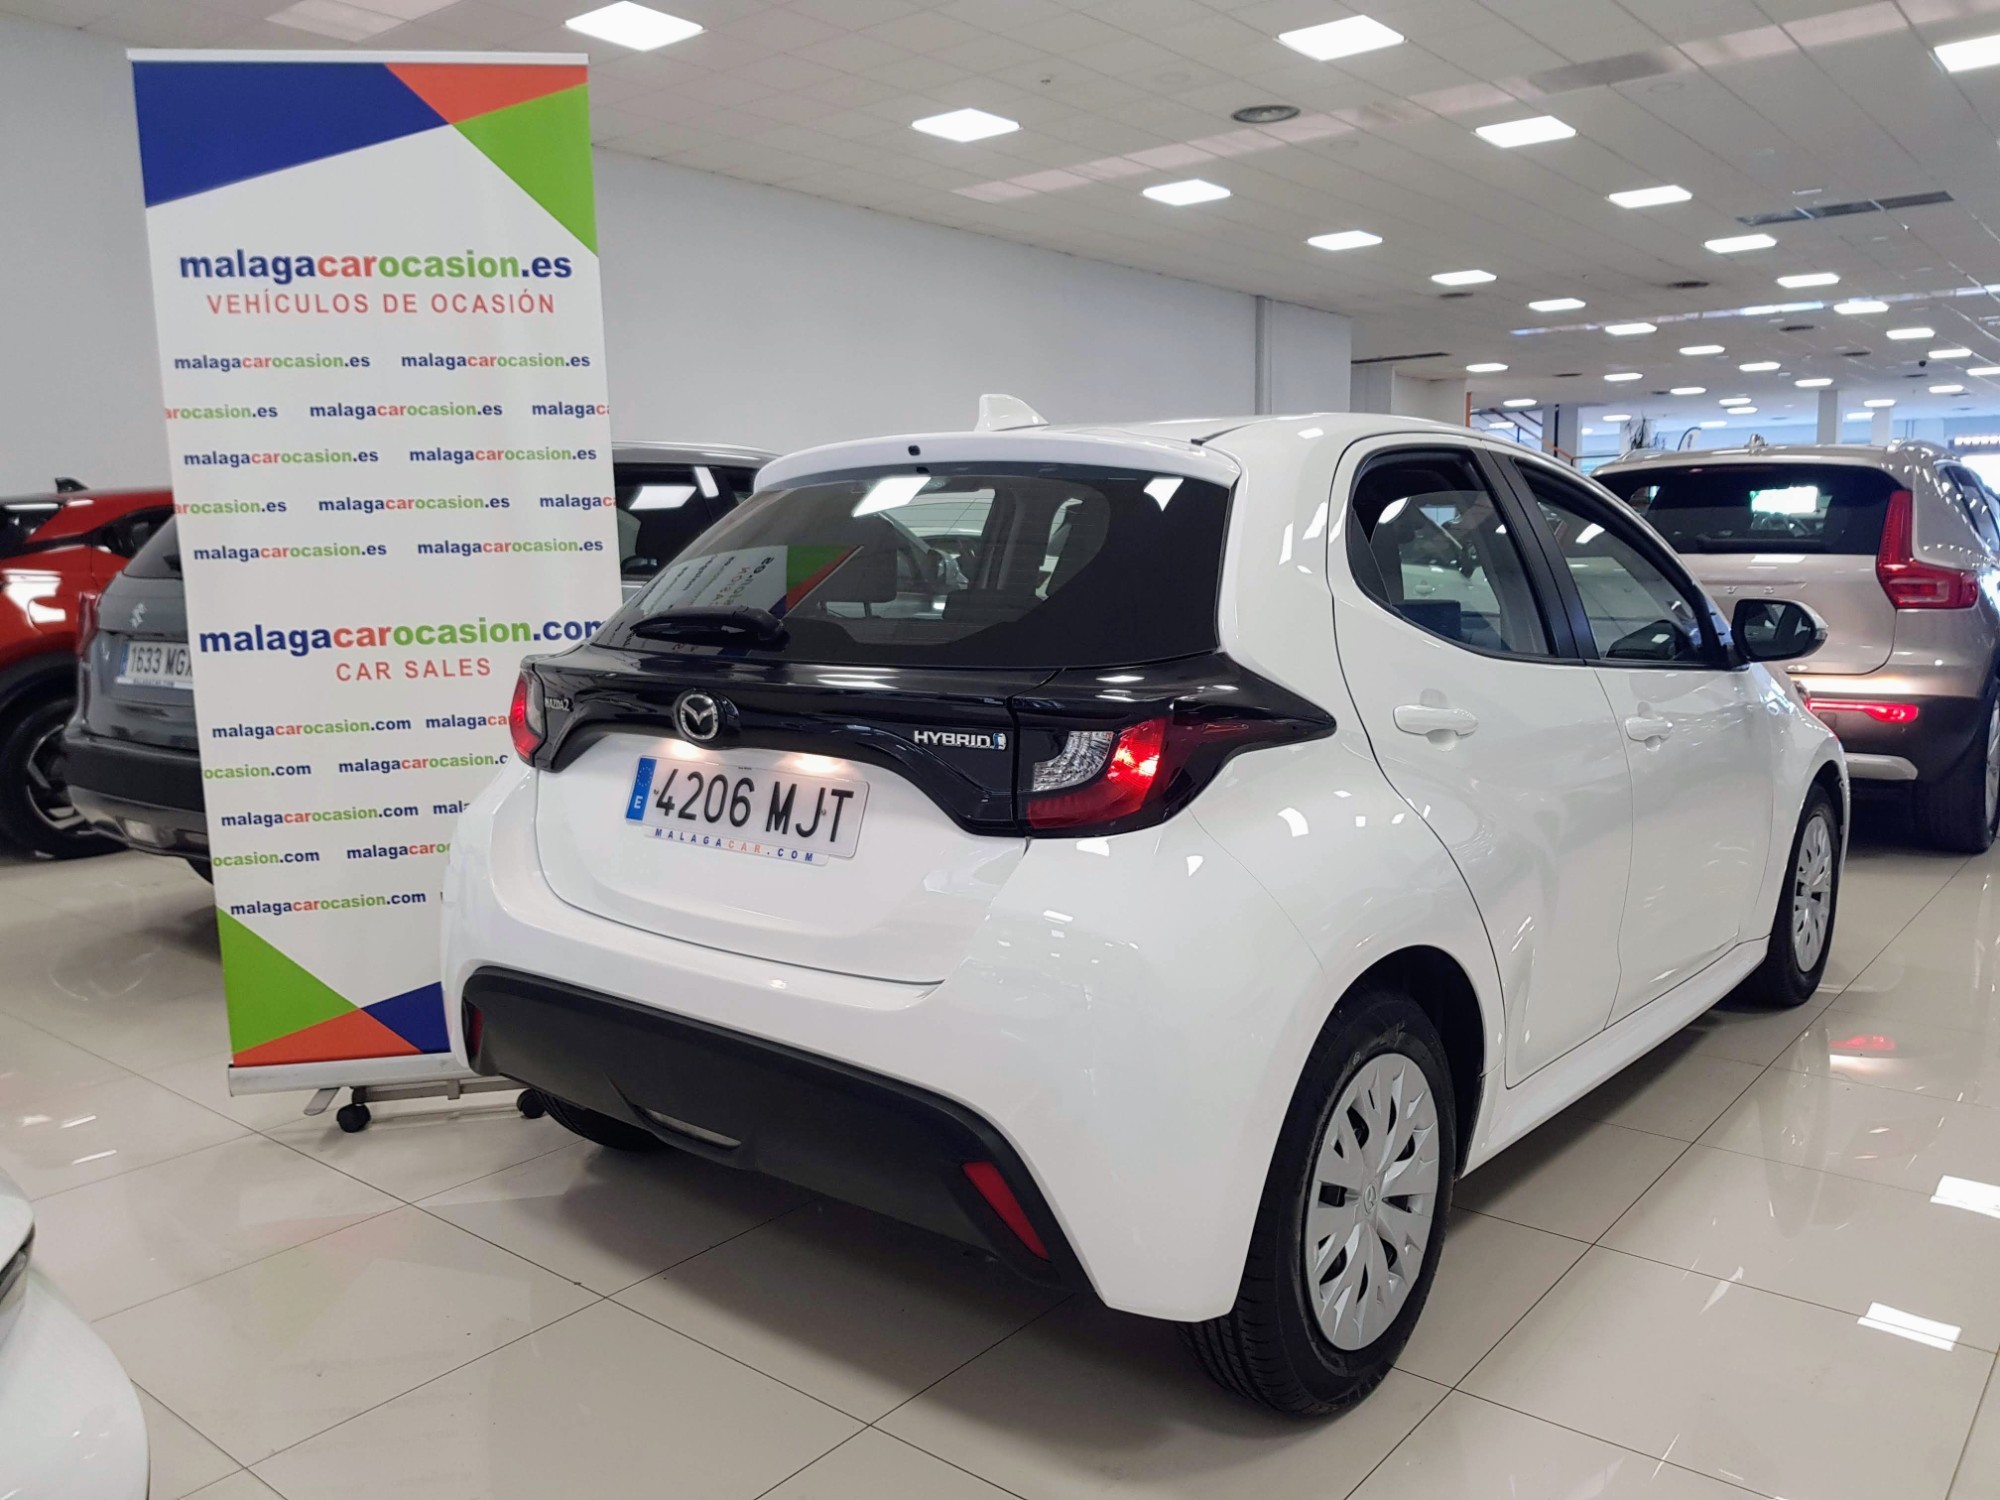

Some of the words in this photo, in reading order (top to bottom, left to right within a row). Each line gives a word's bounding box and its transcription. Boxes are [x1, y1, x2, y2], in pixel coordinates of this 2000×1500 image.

[180, 249, 572, 285] malagacarocasion.es
[207, 290, 368, 314] VEHÍCULOS
[383, 294, 417, 313] DE
[431, 289, 553, 313] OCASIÓN
[175, 354, 370, 372] malagacarocasion.es
[401, 353, 590, 370] malagacarocasion.es
[310, 402, 503, 420] malagacarocasion.es
[184, 450, 378, 468] malagacarocasion.es
[410, 447, 596, 464] malagacarocasion.es
[319, 496, 510, 514] malagacarocasion.es
[194, 543, 387, 562] malagacarocasion.es
[418, 539, 603, 557] malagacarocasion.es
[131, 646, 163, 675] 1633
[336, 662, 391, 681] CAR
[405, 658, 490, 678] SALES
[212, 720, 411, 739] malagacarocasion.com
[425, 714, 510, 730] malagaca
[913, 730, 991, 747] HYBRID
[204, 764, 312, 779] ocasion.com
[633, 795, 643, 809] E
[655, 768, 755, 827] 4206
[765, 781, 855, 843] MJT
[221, 806, 419, 828] malagacarocasion.com
[212, 852, 320, 867] ocasion.com
[230, 893, 426, 916] malagacarocasion.com
